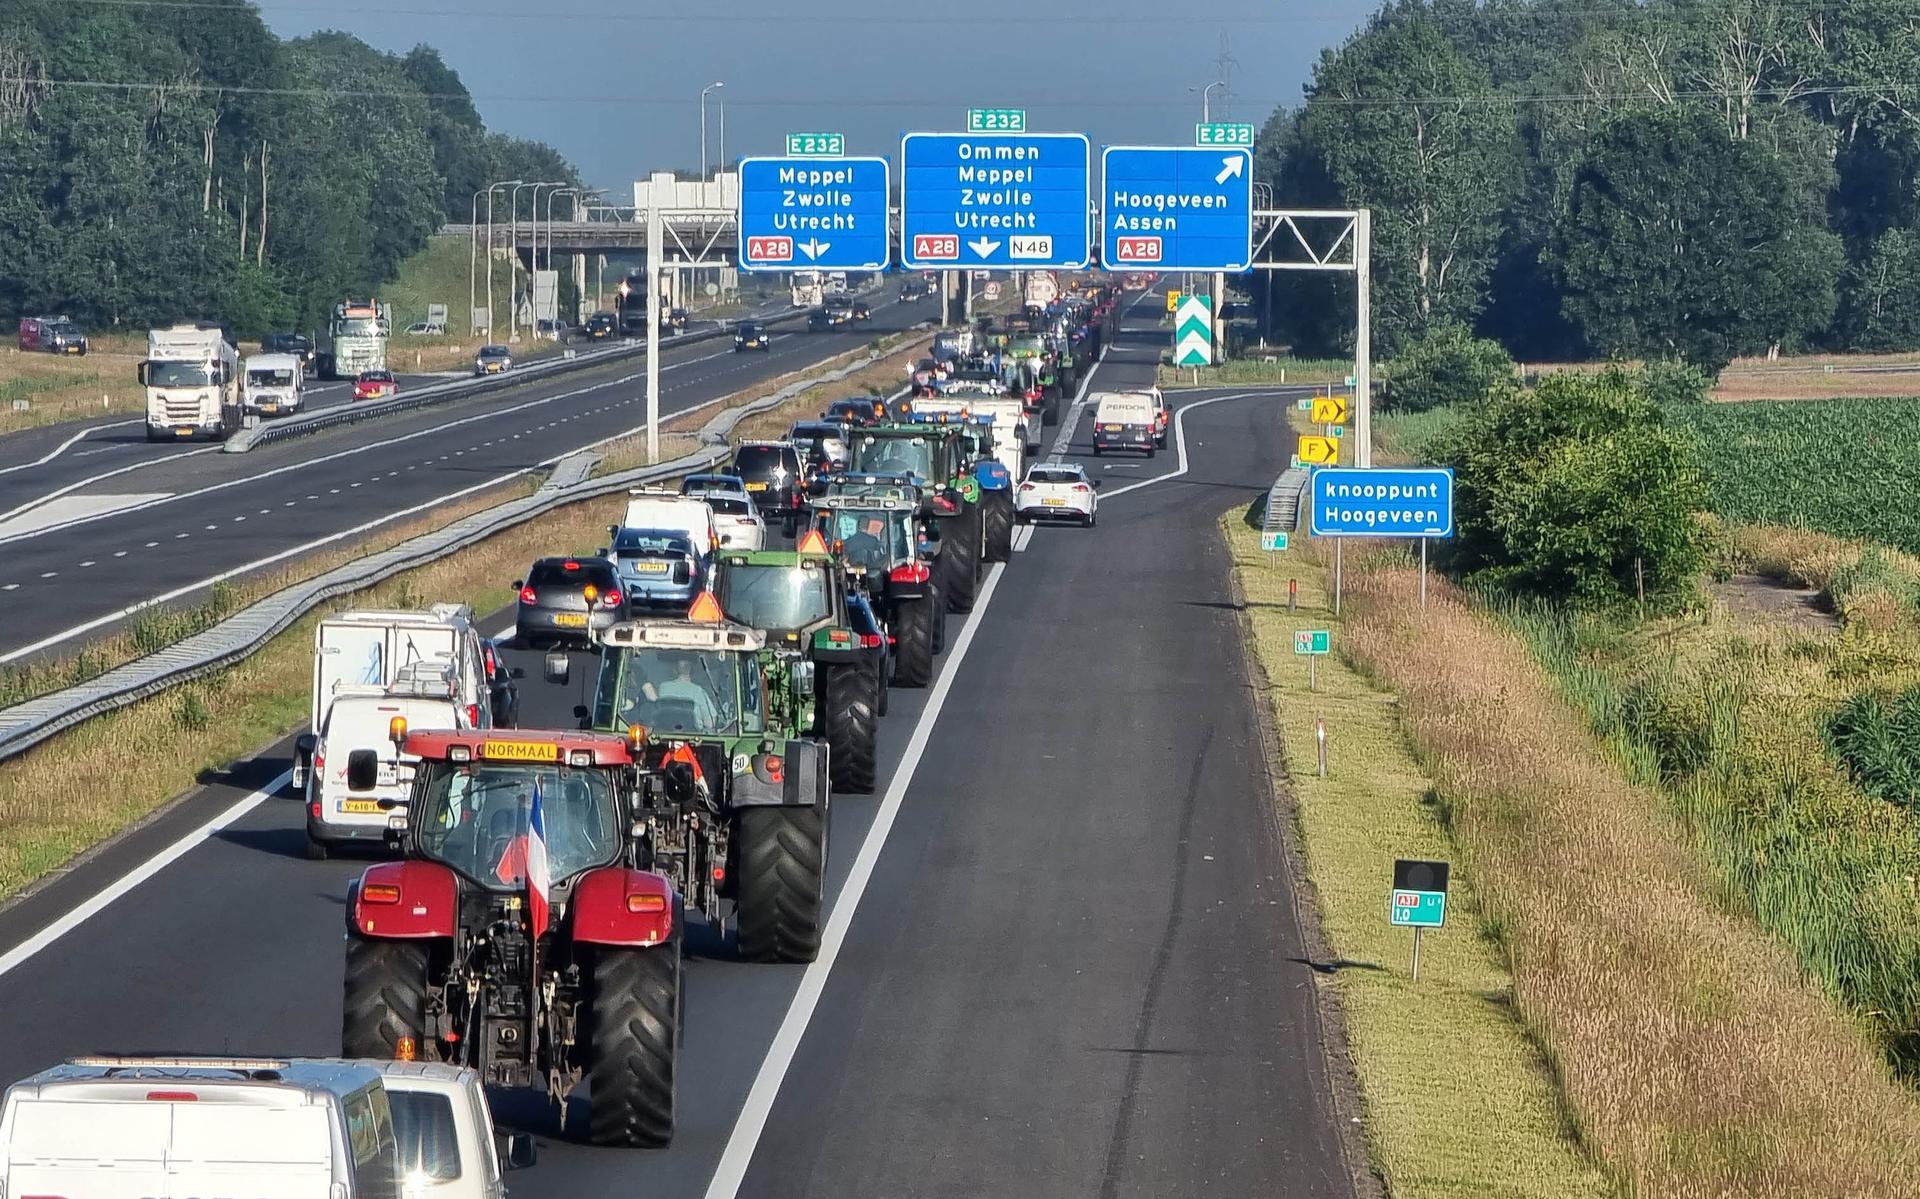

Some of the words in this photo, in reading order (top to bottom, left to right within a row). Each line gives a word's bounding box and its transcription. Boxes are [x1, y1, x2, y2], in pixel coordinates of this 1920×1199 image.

[958, 144, 1039, 159] Ommen
[779, 168, 853, 187] Meppel
[959, 167, 1032, 185] Meppel
[783, 191, 852, 207] Zwolle
[961, 189, 1032, 205] Zwolle
[1114, 191, 1227, 212] Hoogeveen
[774, 213, 855, 230] Utrecht
[955, 212, 1036, 228] Utrecht
[1114, 214, 1176, 231] Assen
[1308, 443, 1319, 456] F
[1325, 481, 1438, 501] knooppunt
[1325, 507, 1439, 528] Hoogeveen
[487, 744, 554, 759] NORMAAL
[735, 756, 745, 769] 50
[1396, 908, 1410, 921] 1.0
